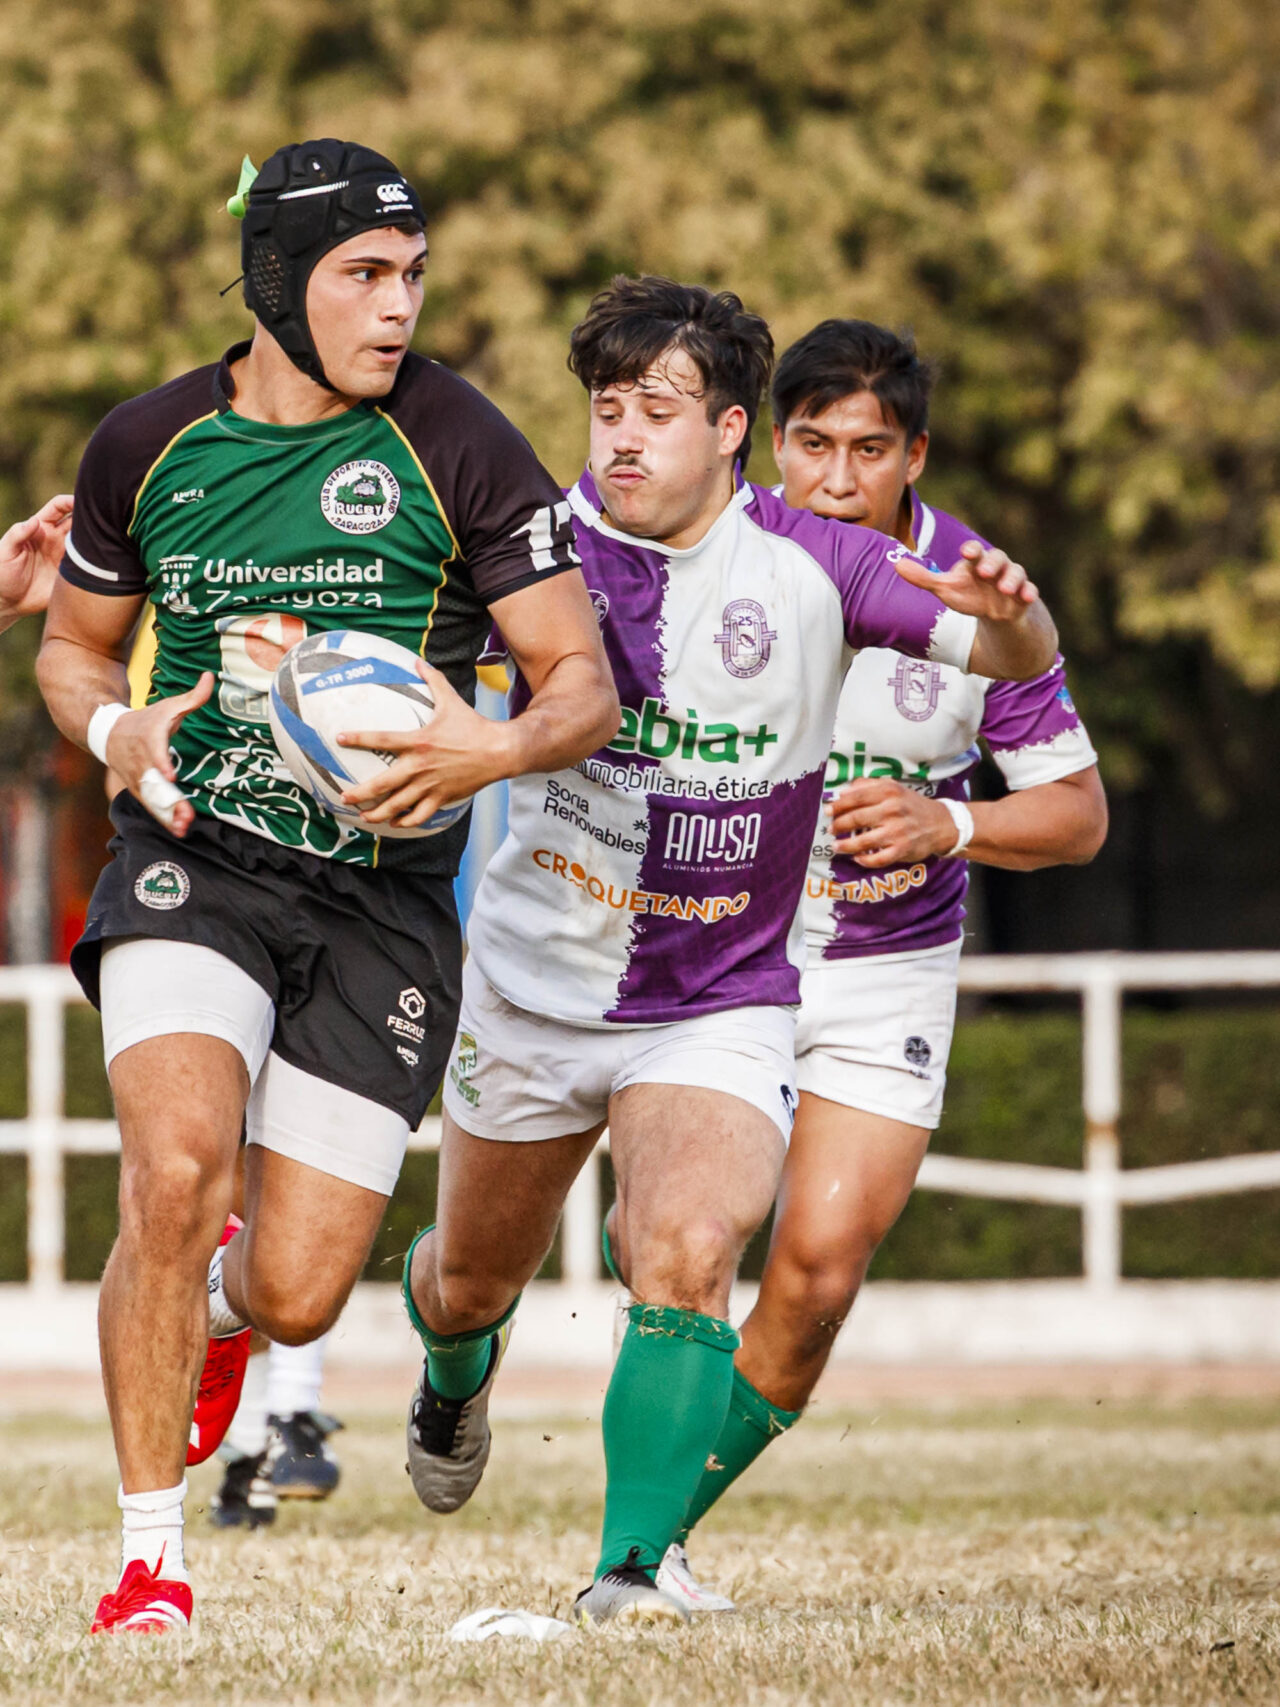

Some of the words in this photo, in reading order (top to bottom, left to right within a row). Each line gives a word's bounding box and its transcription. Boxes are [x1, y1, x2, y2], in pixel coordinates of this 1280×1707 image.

[334, 502, 384, 517] RUGBY
[333, 517, 384, 531] ZARAGOZA
[203, 558, 384, 584] Universidad
[738, 615, 753, 627] 25
[911, 662, 927, 674] 25
[546, 779, 591, 815] Soria
[716, 775, 770, 800] ética
[543, 796, 647, 856] Renovables
[713, 861, 755, 873] NUMANCIA
[532, 849, 751, 924] CROQUETANDO
[806, 863, 927, 903] UETANDO
